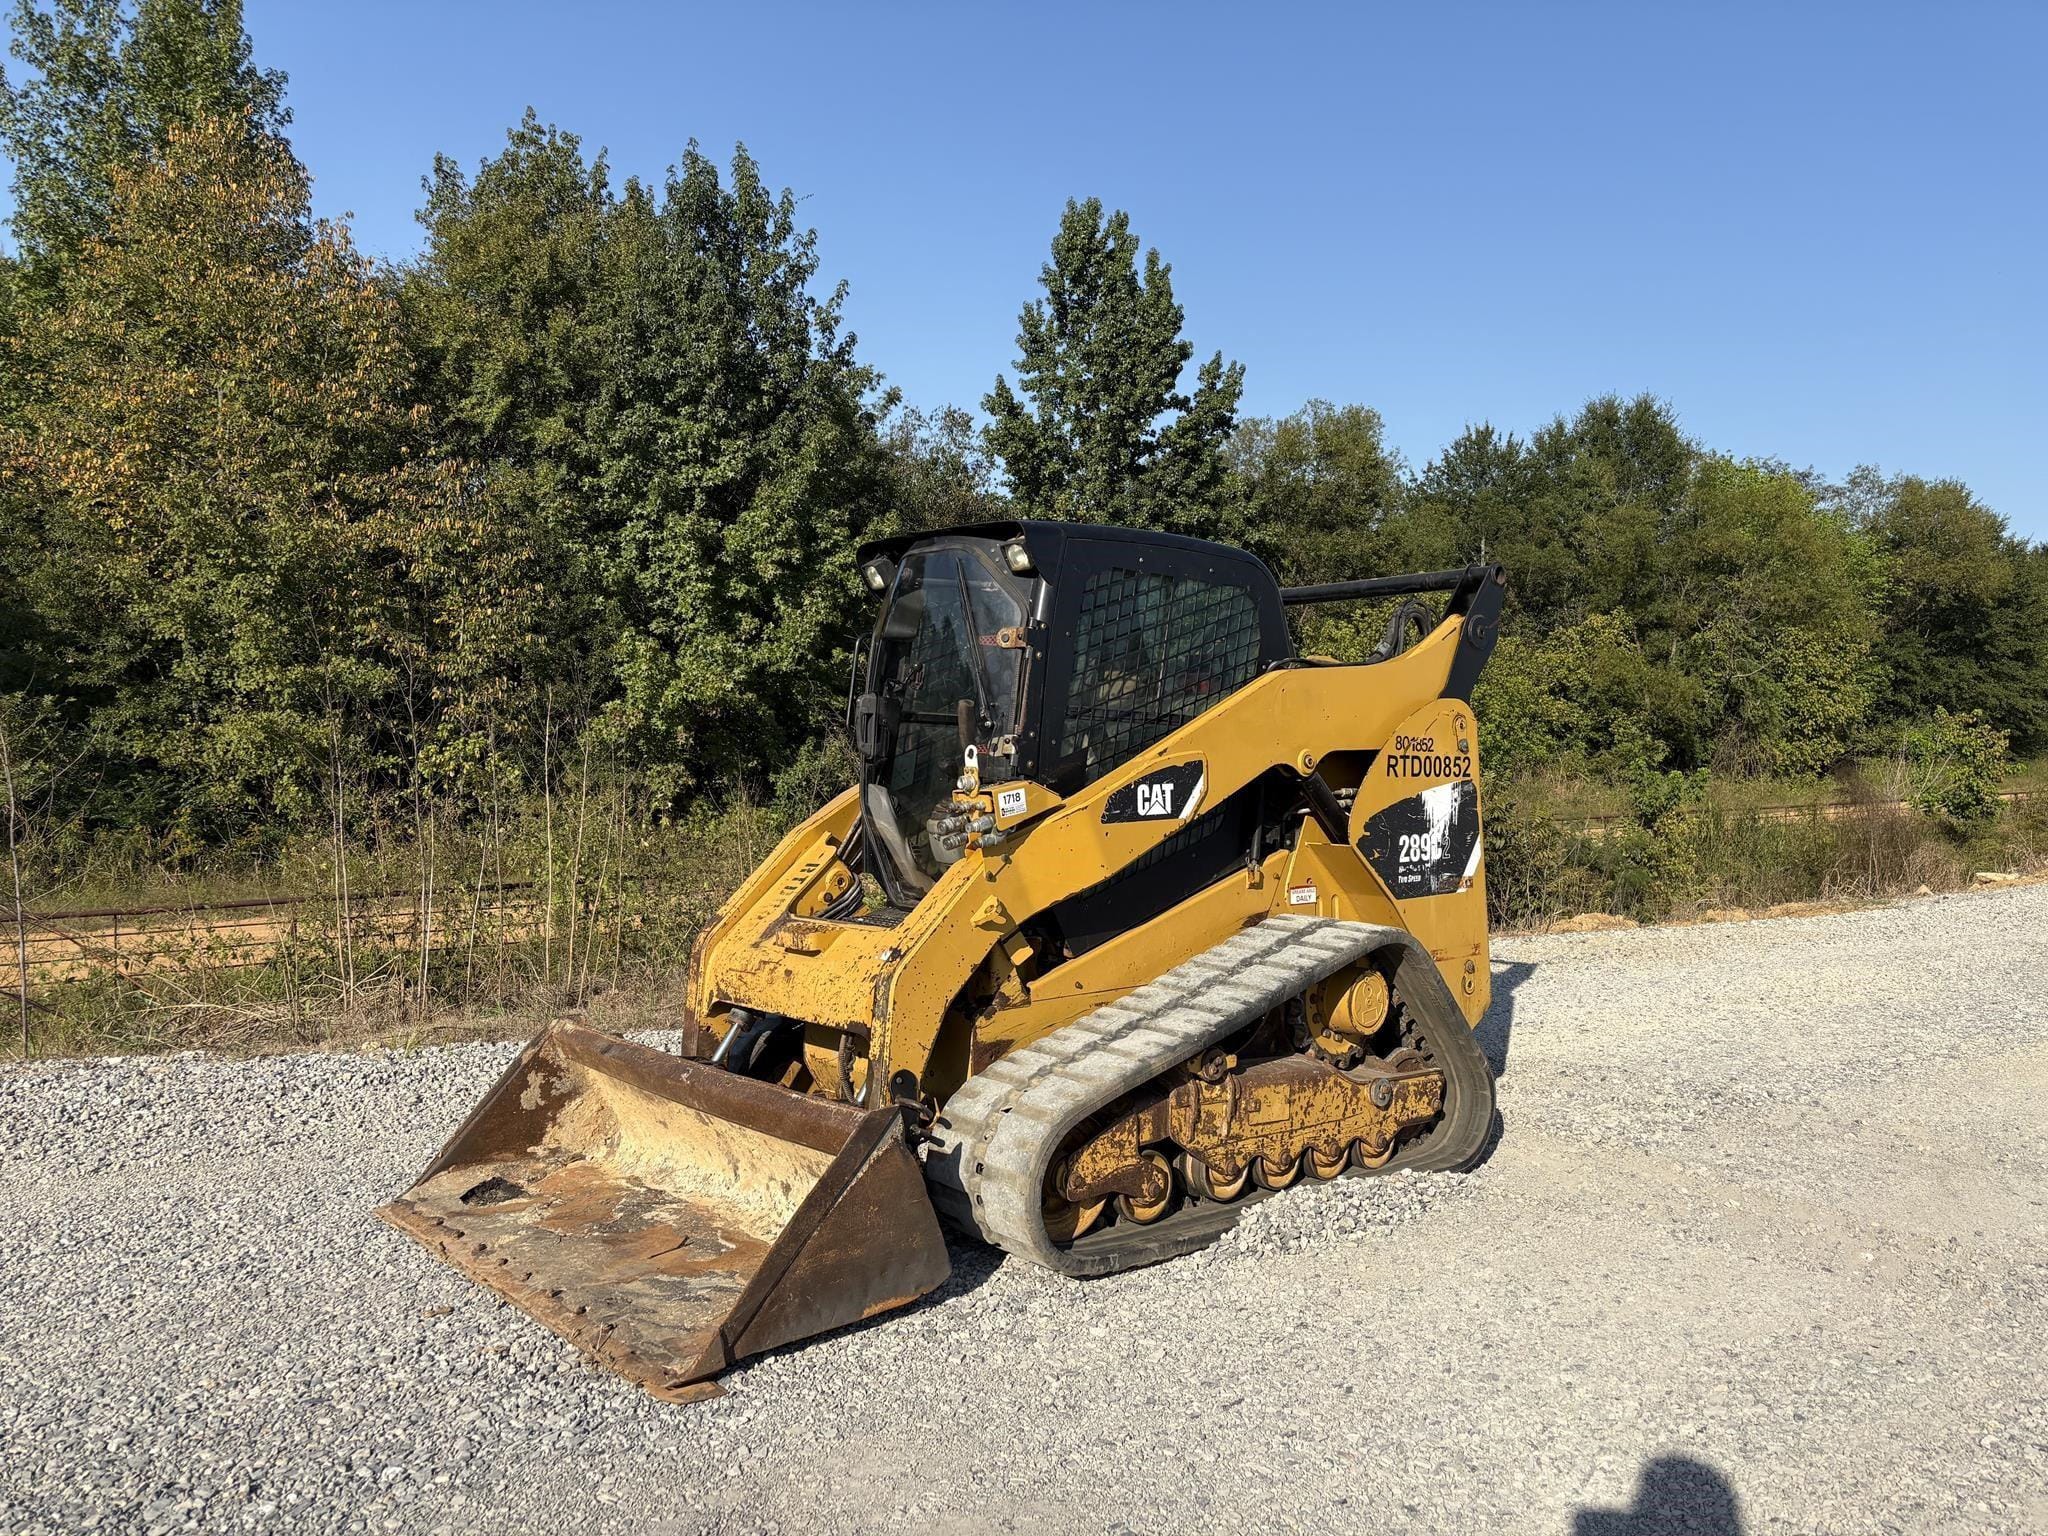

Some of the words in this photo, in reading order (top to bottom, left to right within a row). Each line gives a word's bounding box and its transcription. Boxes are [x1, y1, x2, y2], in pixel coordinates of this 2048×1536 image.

[1387, 755, 1471, 778] RTD00852
[1003, 792, 1021, 805] 1718
[1137, 783, 1174, 816] CAT
